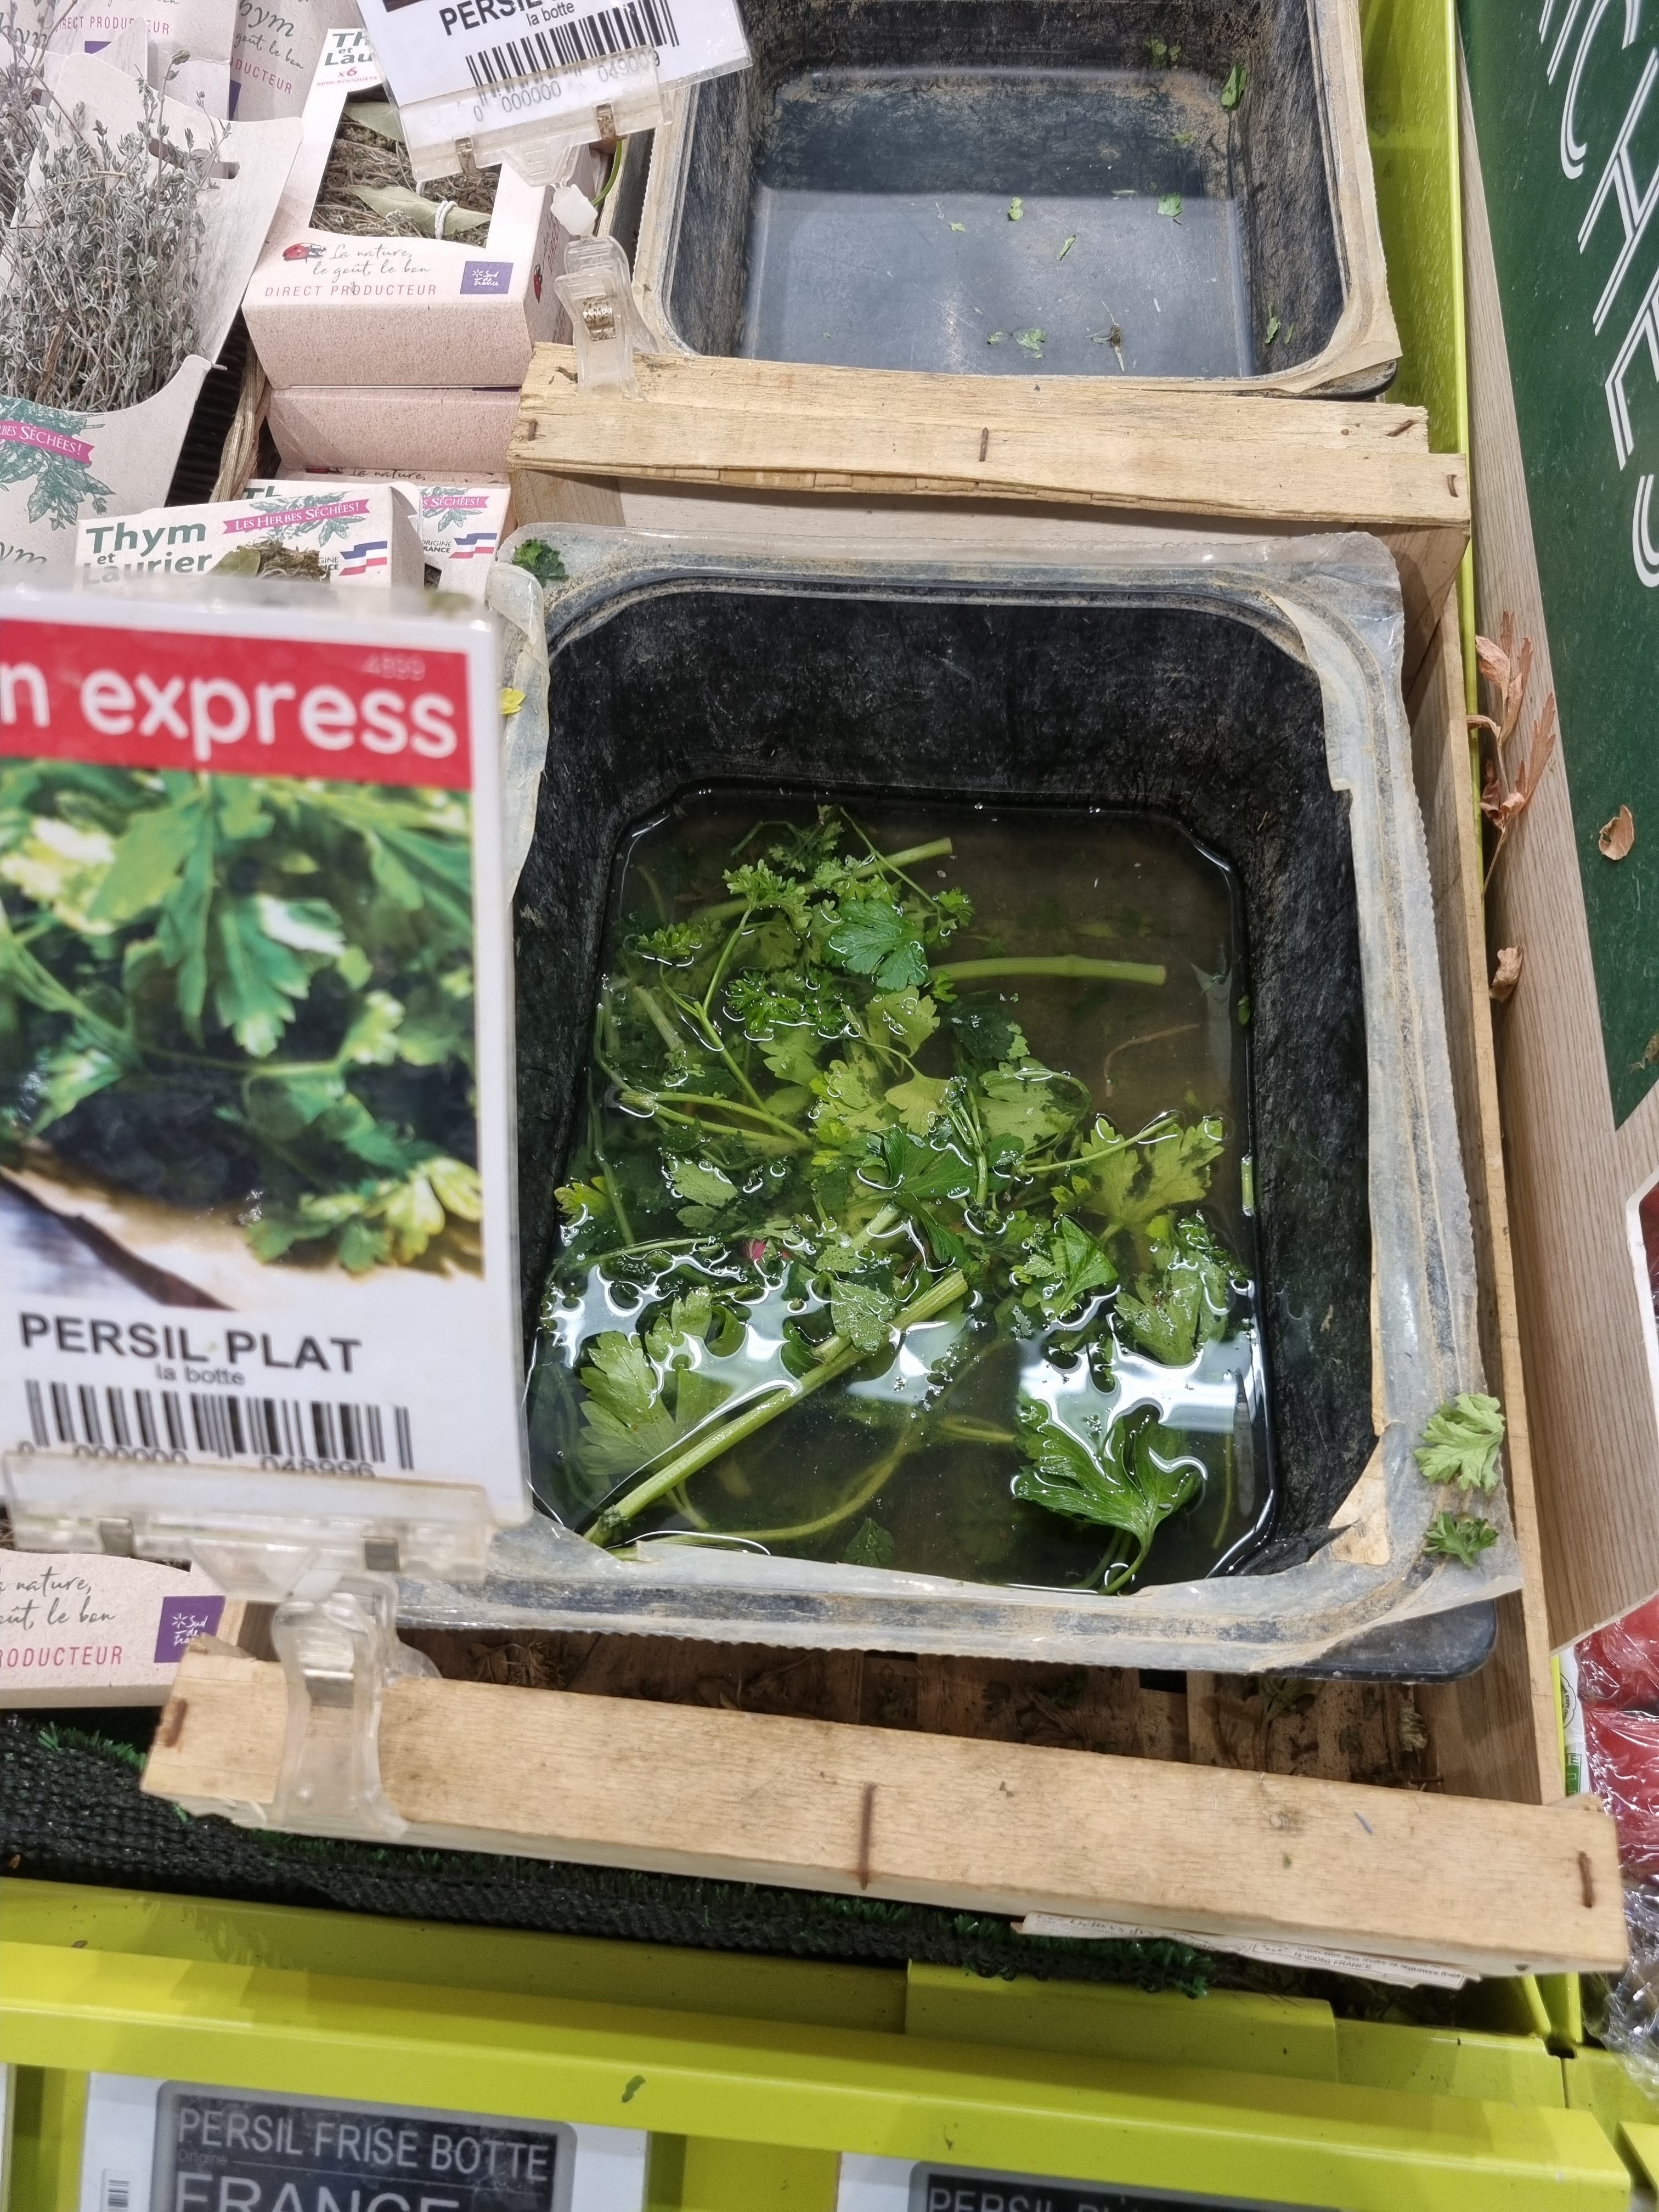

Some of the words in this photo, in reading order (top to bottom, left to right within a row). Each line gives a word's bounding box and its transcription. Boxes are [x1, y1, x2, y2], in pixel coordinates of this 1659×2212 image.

[56, 16, 84, 32] IRECT
[526, 13, 540, 27] la
[541, 2, 575, 22] botte
[332, 31, 370, 48] Th
[230, 57, 292, 95] DUCTEUR
[338, 66, 358, 77] x6
[501, 81, 562, 113] 000000
[329, 244, 348, 259] La
[354, 245, 413, 259] nature,
[313, 259, 329, 275] le
[381, 260, 396, 274] le
[404, 264, 431, 274] bon
[483, 270, 499, 279] Sud
[265, 286, 323, 297] DIRECT
[330, 285, 437, 297] PRODUCTEUR
[235, 519, 255, 531] LES
[257, 512, 302, 528] HERBES
[86, 522, 206, 557] Thym
[97, 553, 116, 565] et
[80, 669, 458, 762] express
[19, 1311, 210, 1362] PERSIL
[225, 1329, 362, 1373] PLAT
[156, 1363, 177, 1380] la
[184, 1364, 246, 1386] botte
[16, 1566, 92, 1596] nature,
[47, 1598, 70, 1625] le
[80, 1596, 116, 1623] bon
[187, 1615, 208, 1628] Sud
[1333, 1959, 1372, 1970] FRANCE
[178, 2107, 303, 2156] PERSIL
[314, 2121, 419, 2168] FRISE
[431, 2133, 549, 2182] BOTTE
[176, 2171, 460, 2212] FRA
